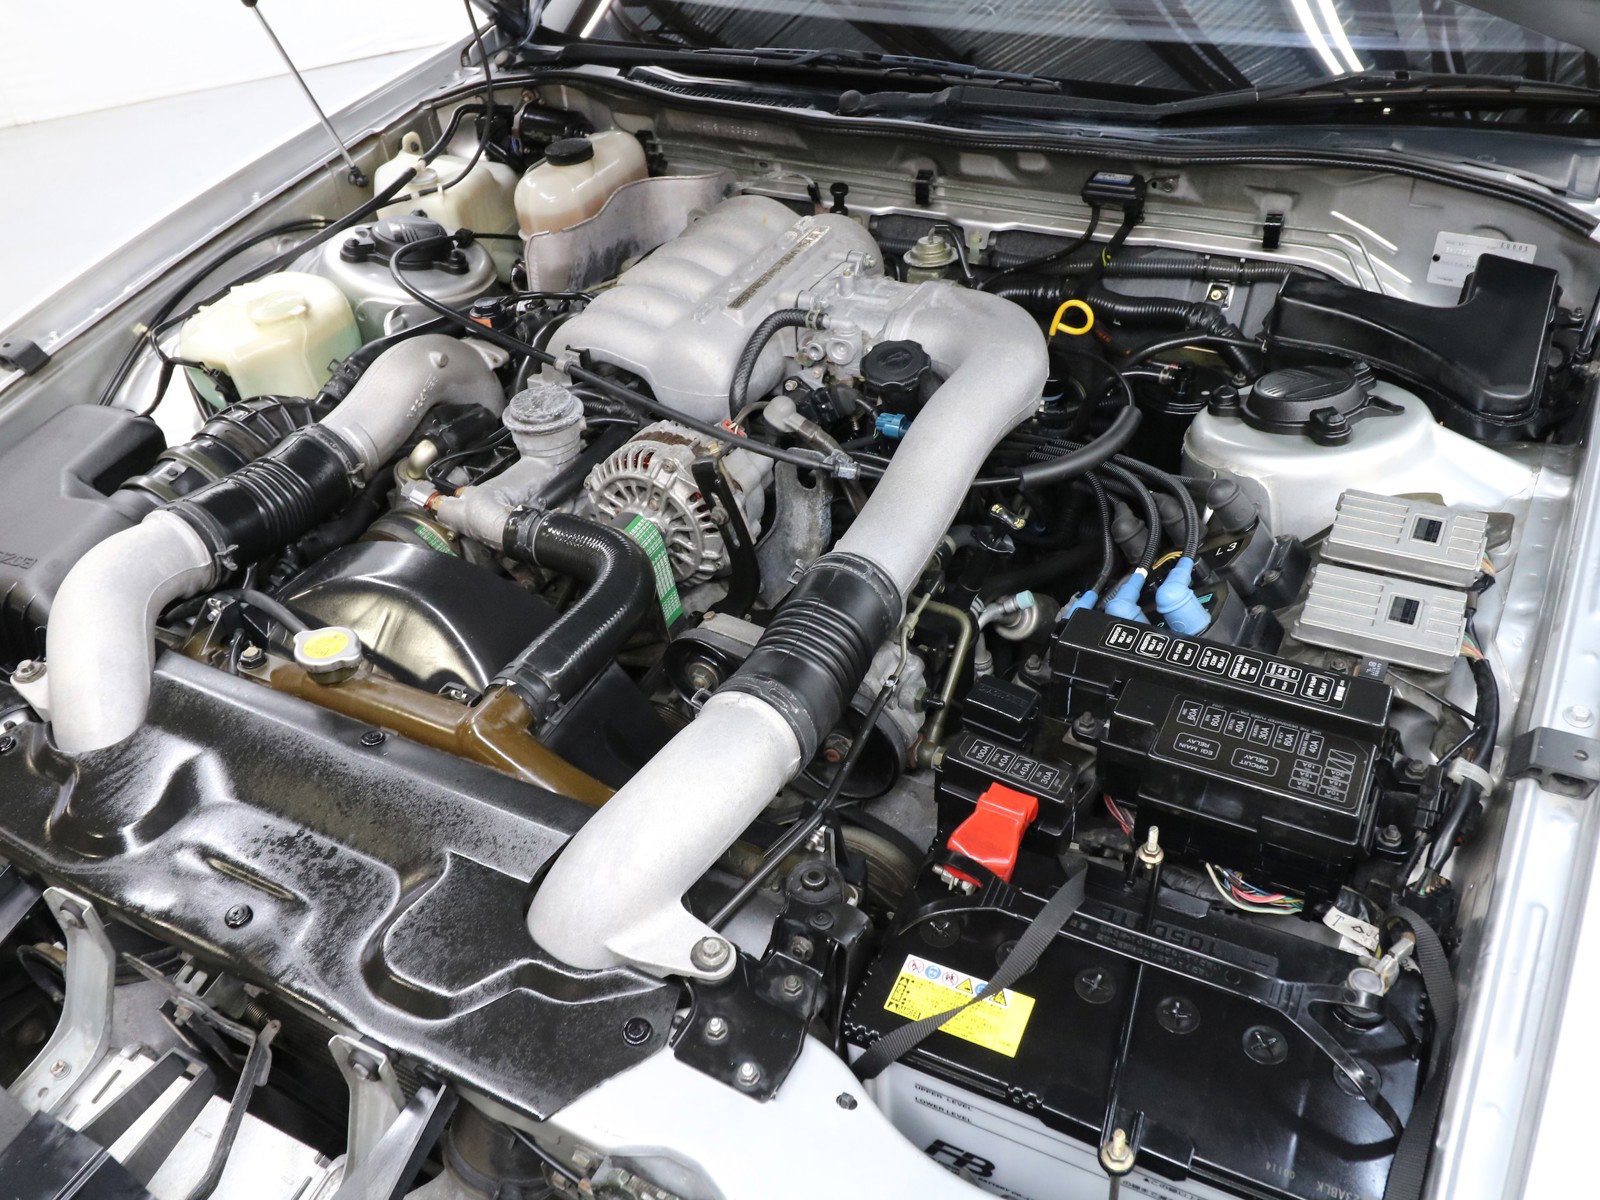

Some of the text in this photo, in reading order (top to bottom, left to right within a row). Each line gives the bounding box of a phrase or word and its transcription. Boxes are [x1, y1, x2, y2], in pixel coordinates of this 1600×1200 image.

[1118, 631, 1127, 643] RELAY
[1148, 638, 1157, 650] RELAY
[1184, 648, 1193, 660] RELAY
[1201, 656, 1210, 668] LOCK
[1217, 656, 1226, 668] RELAY
[1241, 662, 1250, 675] RELAY
[1309, 676, 1317, 688] PUMP
[1319, 682, 1327, 695] RELAY
[1210, 714, 1221, 726] 60A
[1235, 721, 1245, 733] 40A
[1258, 728, 1270, 740] 30A
[1283, 734, 1294, 746] 60A
[1179, 742, 1198, 751] MAIN
[1186, 738, 1211, 748] RELAY
[1308, 741, 1319, 753] 40A
[976, 745, 990, 760] 100A
[998, 754, 1011, 767] 40A
[1243, 754, 1269, 764] RELAY
[1020, 762, 1032, 776] 40A
[1239, 760, 1269, 771] CIRCUIT
[1041, 772, 1053, 784] 30A
[915, 1083, 972, 1111] UPPER LEVEL
[915, 1096, 971, 1122] LOWER LEVEL
[924, 1140, 995, 1177] FB
